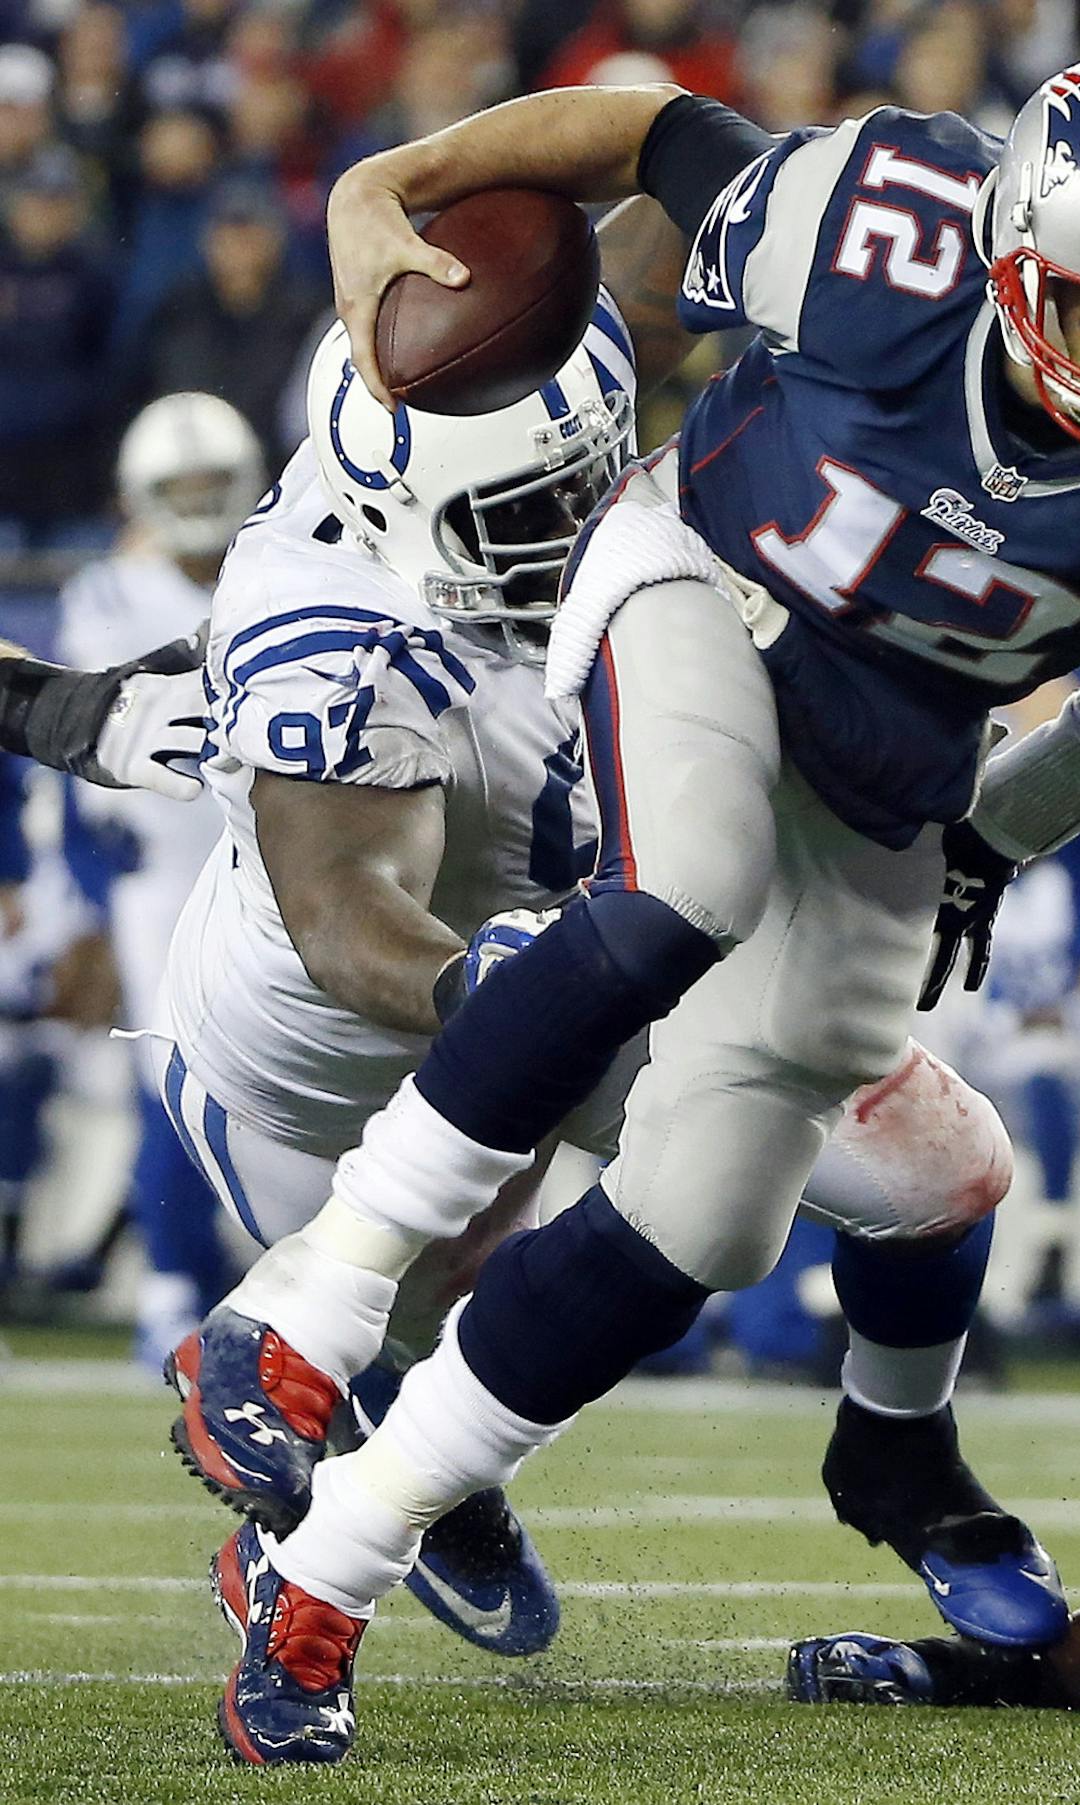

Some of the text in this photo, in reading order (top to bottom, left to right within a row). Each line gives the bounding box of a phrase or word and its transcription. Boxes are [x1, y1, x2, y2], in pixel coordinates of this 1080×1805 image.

[830, 142, 982, 301] 12
[921, 488, 1005, 555] Patriots
[267, 684, 376, 782] 97
